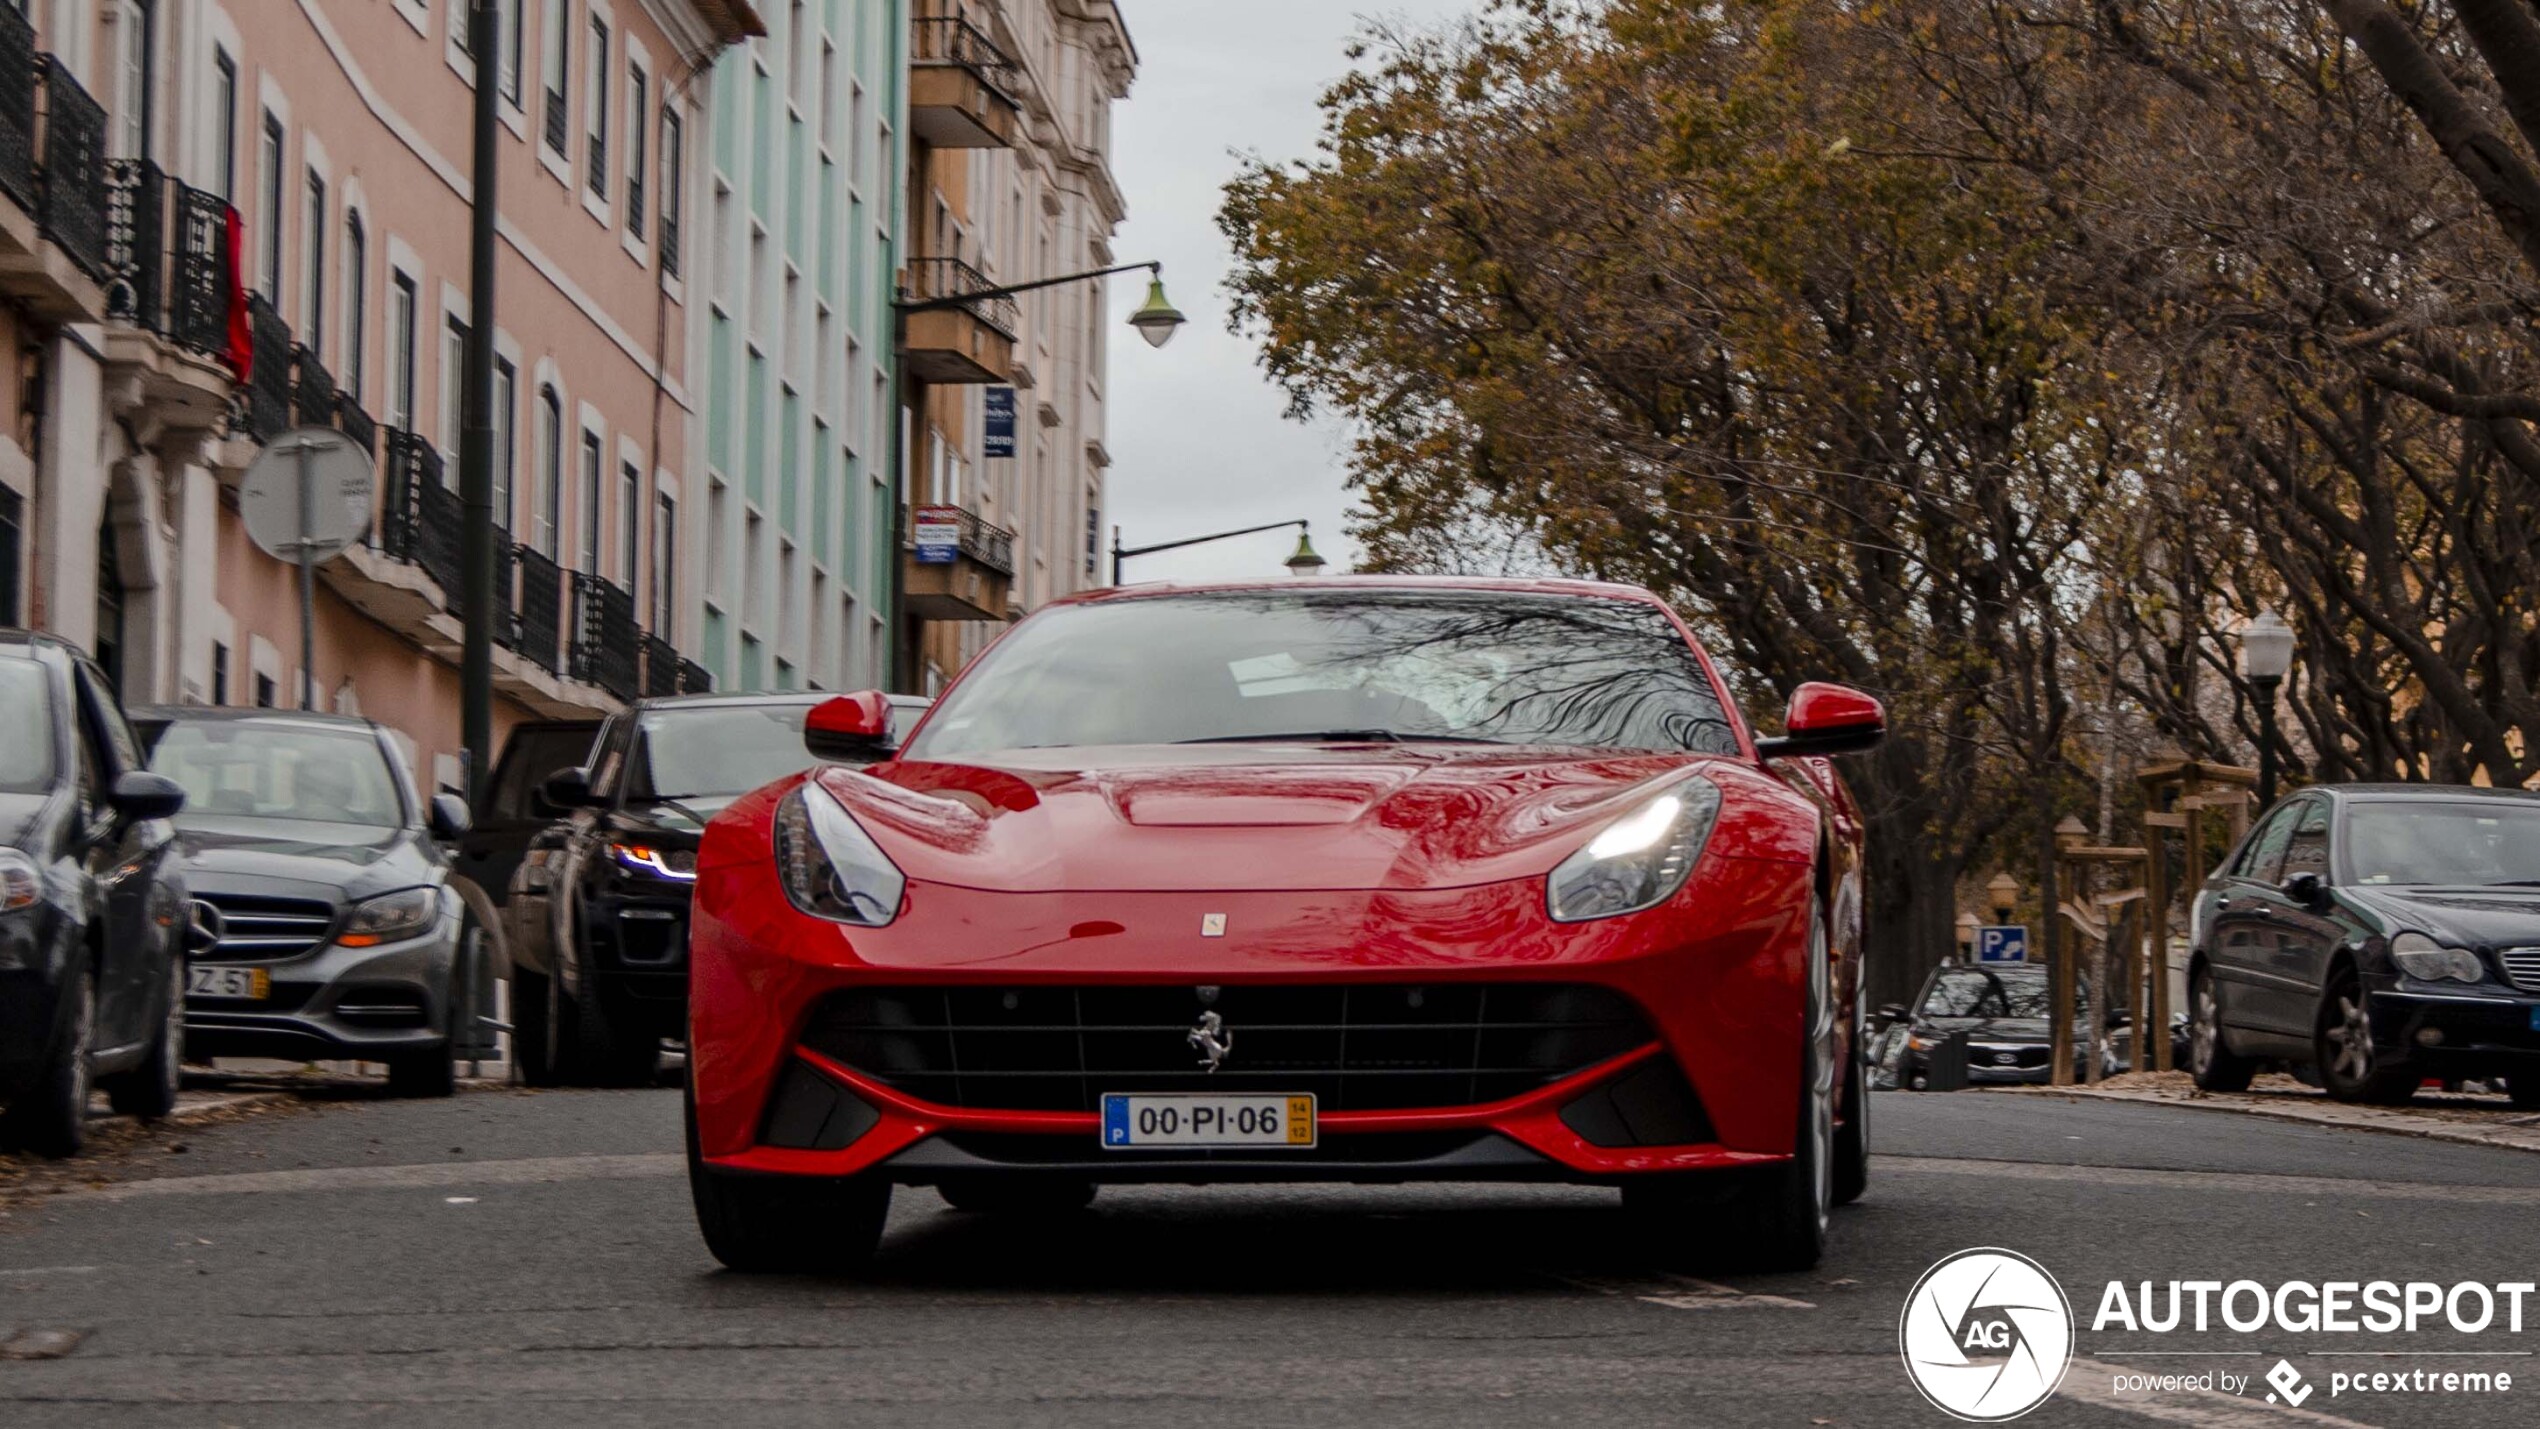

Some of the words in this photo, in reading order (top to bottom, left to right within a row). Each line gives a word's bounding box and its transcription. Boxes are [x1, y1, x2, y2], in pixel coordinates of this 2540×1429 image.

[1984, 931, 2003, 953] P
[1292, 1103, 1306, 1113] 14
[1112, 1128, 1124, 1143] P
[1292, 1128, 1306, 1138] 12
